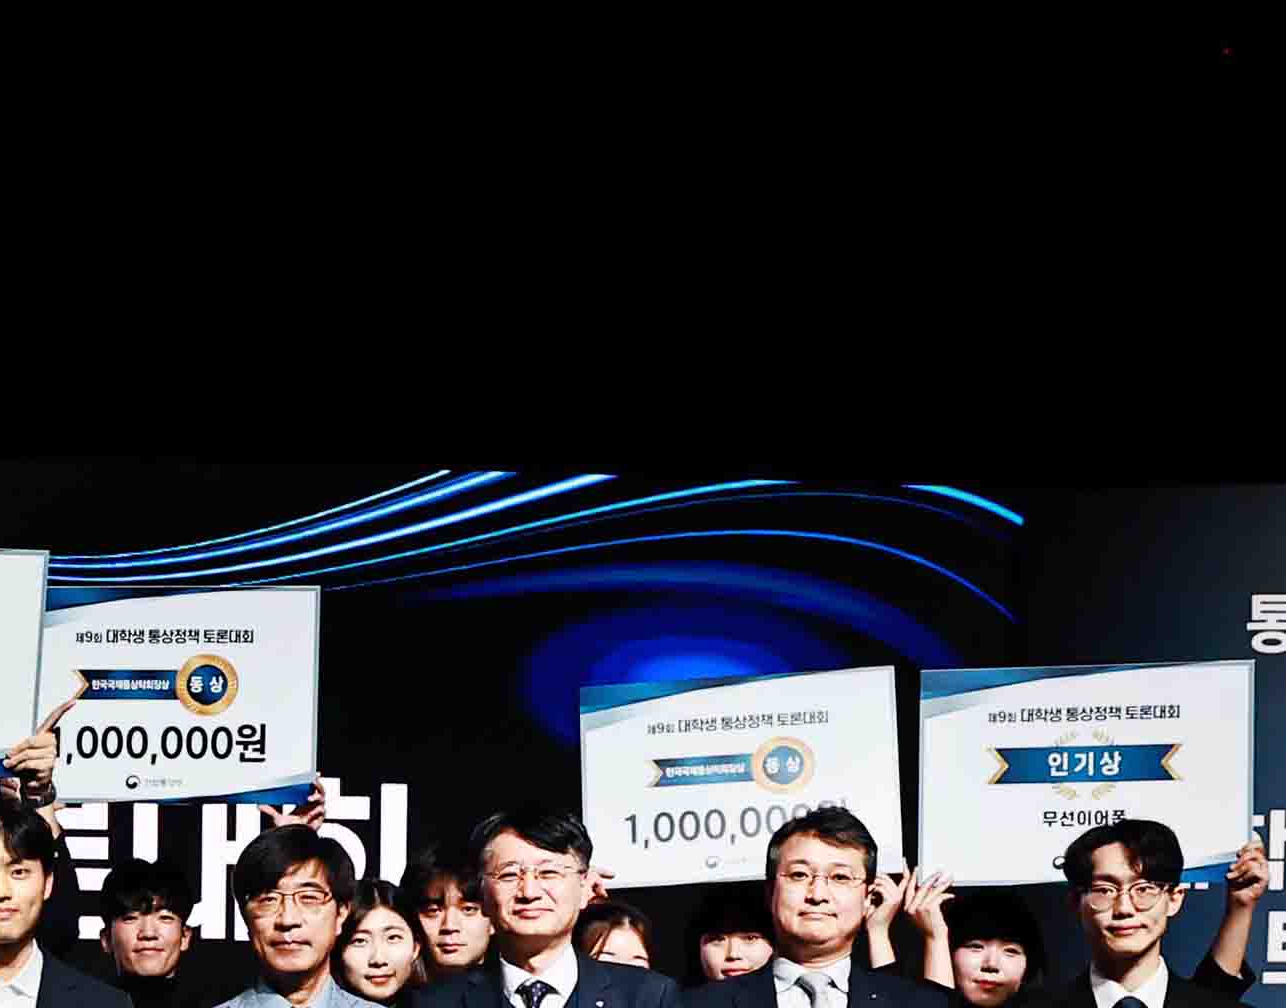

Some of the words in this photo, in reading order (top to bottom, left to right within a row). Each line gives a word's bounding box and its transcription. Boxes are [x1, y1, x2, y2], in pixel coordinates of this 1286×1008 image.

[76, 631, 102, 644] 제9회
[106, 629, 145, 643] 대학생
[148, 629, 199, 644] 통상정책
[203, 629, 254, 644] 토론대회
[678, 718, 717, 733] 대학생
[721, 714, 773, 730] 통상정책
[777, 711, 828, 726] 토론대회
[988, 711, 1016, 723] 제9회
[1020, 708, 1062, 723] 대학생
[1065, 706, 1122, 722] 통상정책
[1125, 704, 1180, 720] 토론대회
[1047, 752, 1122, 776] 인기상
